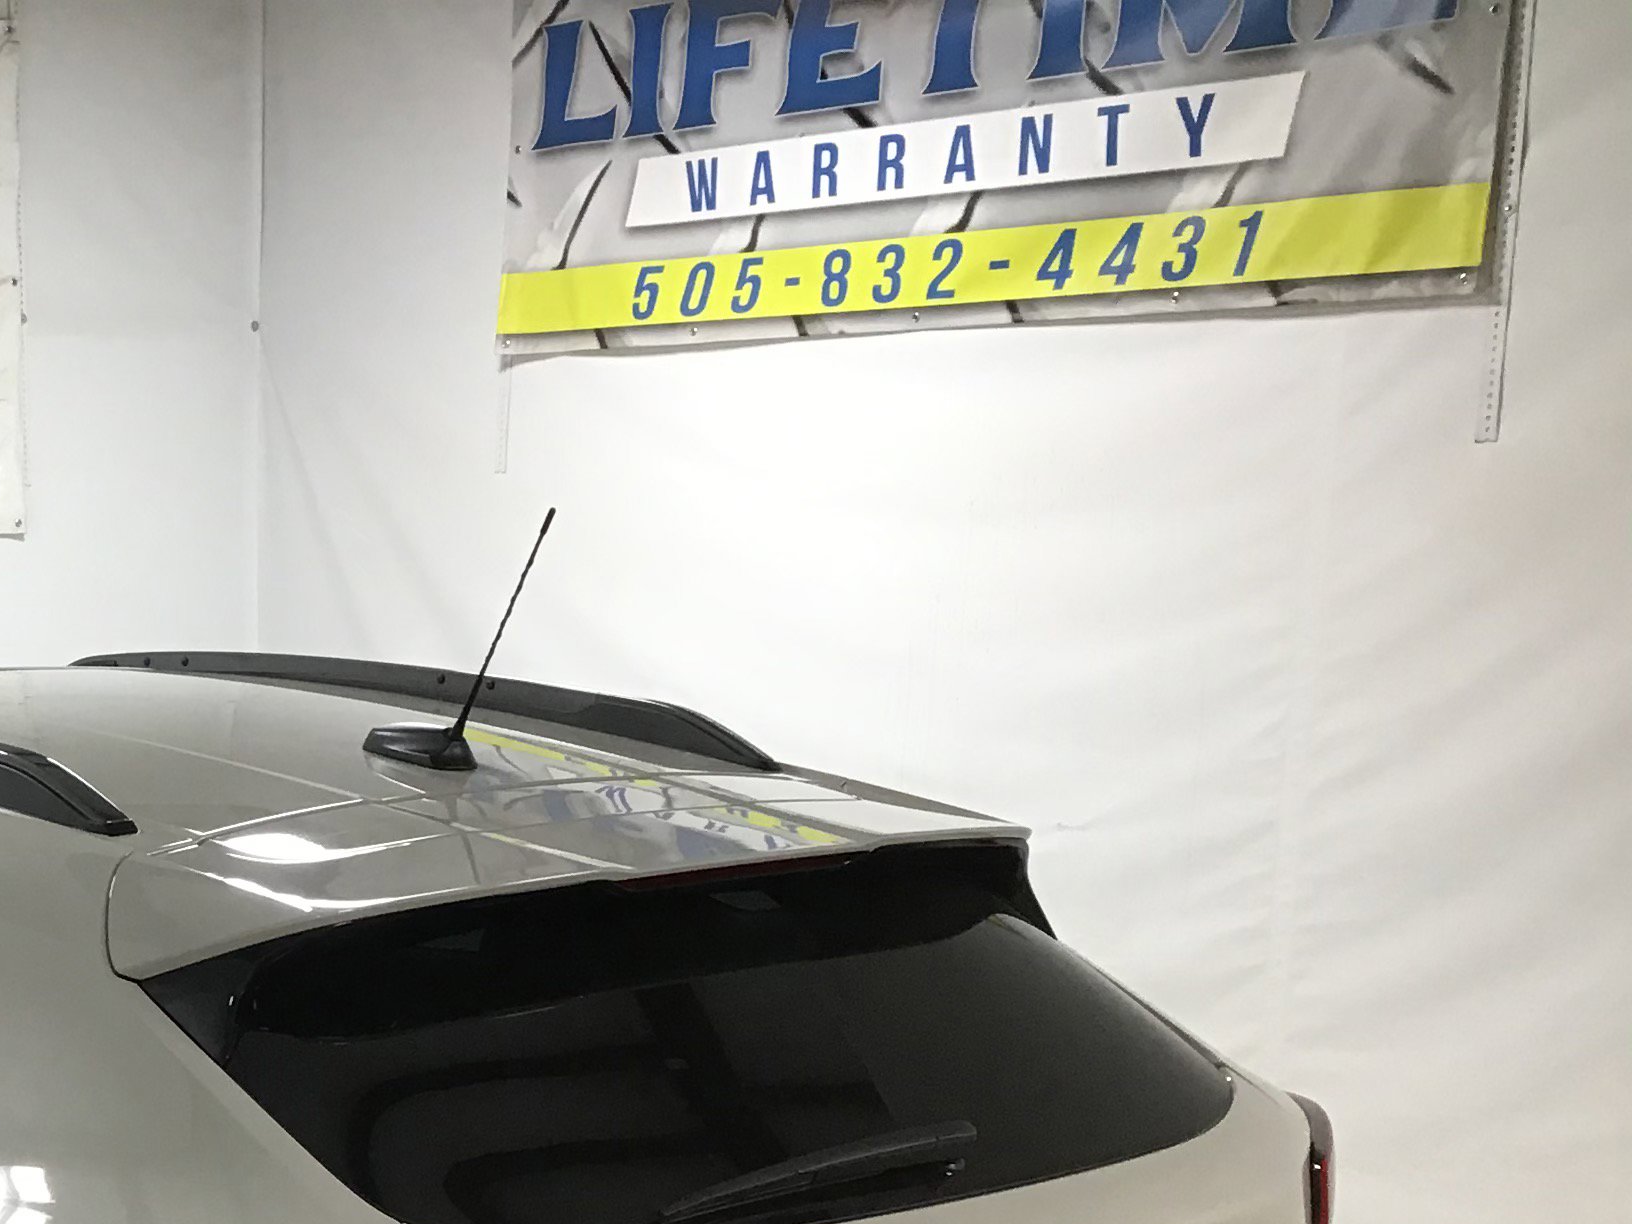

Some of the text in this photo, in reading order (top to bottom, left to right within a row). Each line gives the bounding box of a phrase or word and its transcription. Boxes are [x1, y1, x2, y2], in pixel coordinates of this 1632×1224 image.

[531, 0, 1458, 151] LIFETI
[685, 93, 1216, 214] WARRANTY
[632, 211, 1266, 320] 505-832-4431
